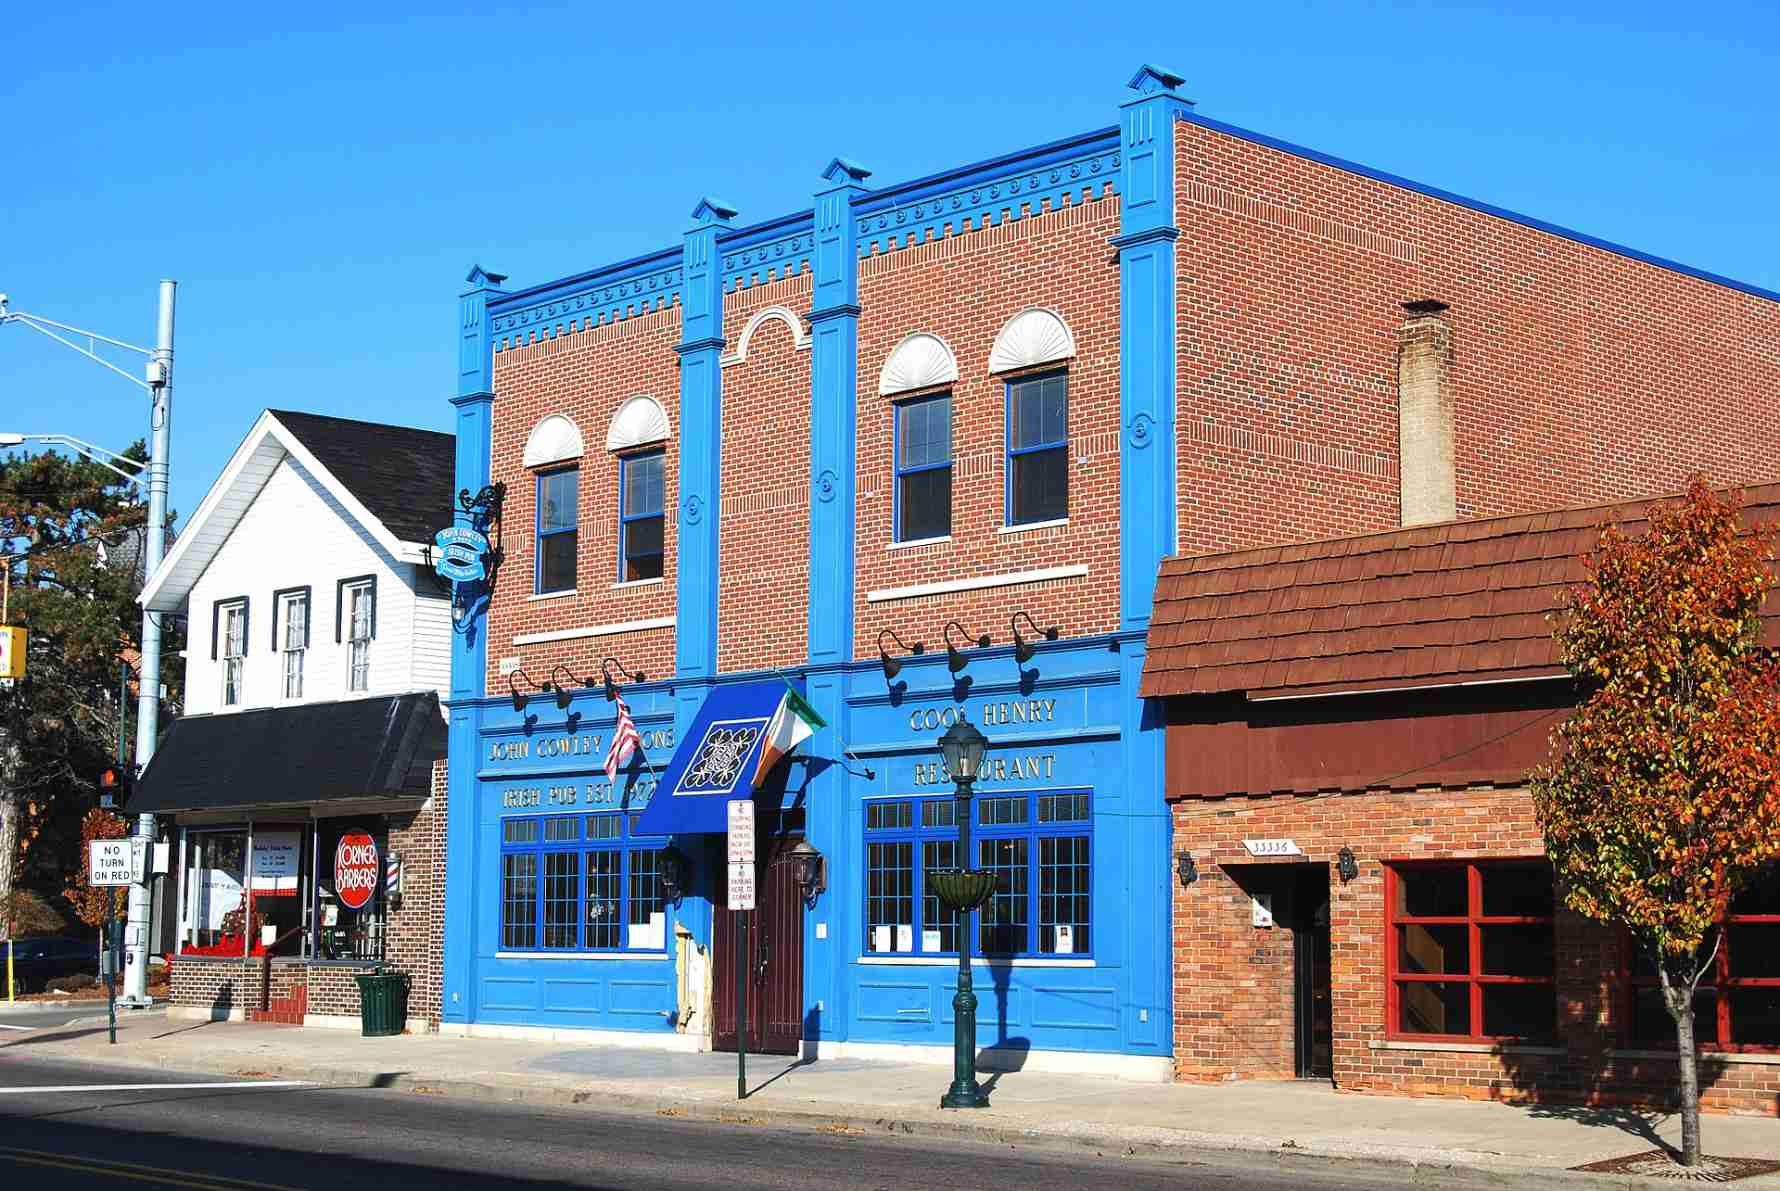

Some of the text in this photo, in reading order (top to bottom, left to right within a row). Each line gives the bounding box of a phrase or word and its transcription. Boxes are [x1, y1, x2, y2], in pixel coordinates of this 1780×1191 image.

[983, 699, 1056, 726] HENRY
[489, 728, 674, 761] JOHN COWLEY ONS
[914, 755, 1056, 785] RESURANT
[504, 787, 540, 808] IRISH
[550, 785, 577, 805] PUB
[586, 783, 613, 804] EST
[100, 858, 124, 868] TURN
[104, 846, 120, 855] NO
[338, 843, 376, 868] KORNER
[94, 870, 130, 880] ON RED
[336, 867, 377, 893] BARBERS
